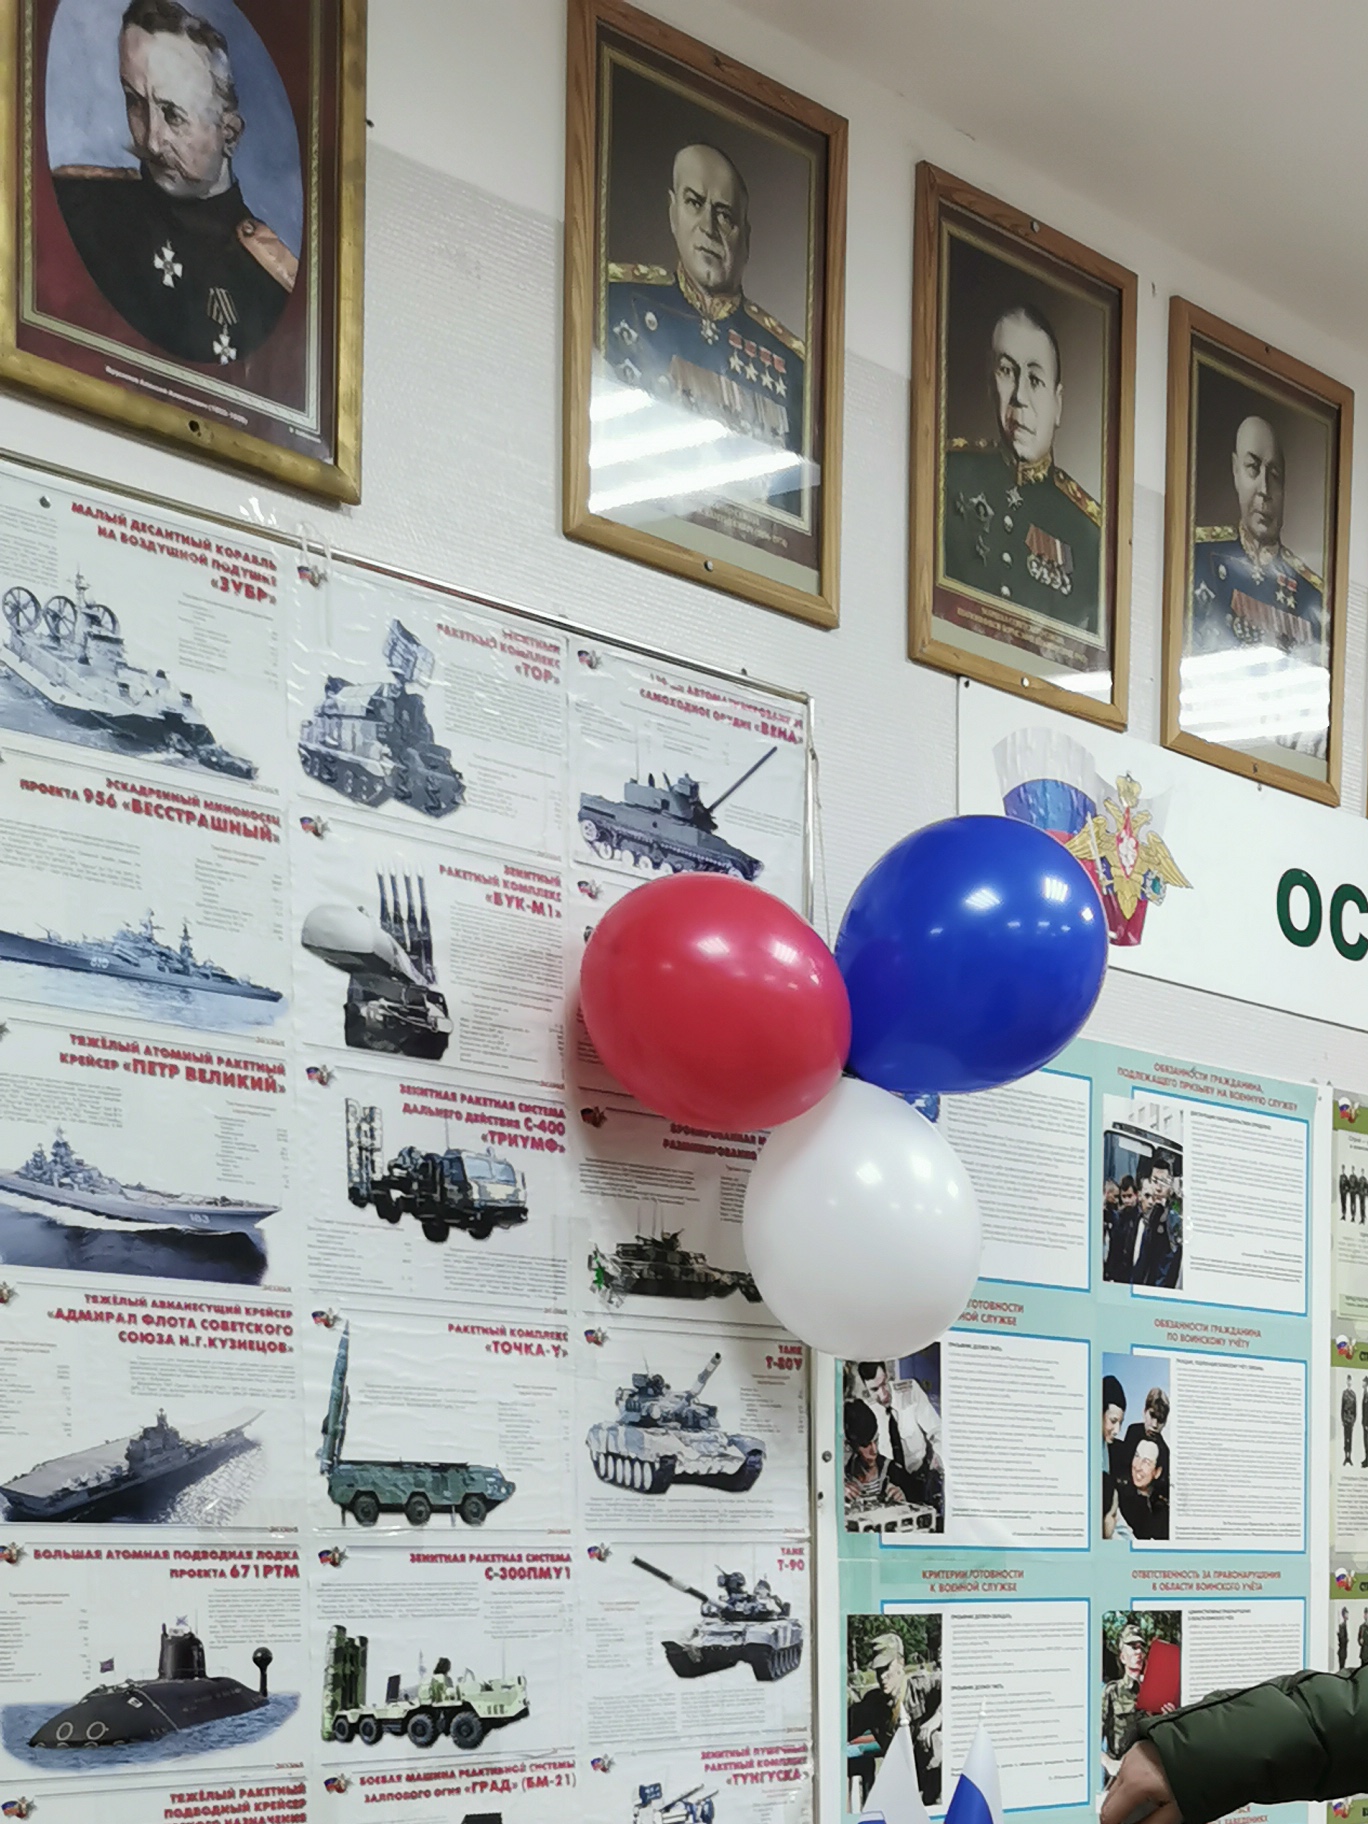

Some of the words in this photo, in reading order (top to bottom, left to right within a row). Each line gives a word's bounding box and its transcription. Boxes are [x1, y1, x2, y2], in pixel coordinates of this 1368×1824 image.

[71, 502, 127, 526] МАЛЫЙ
[130, 519, 212, 550] ДЕСАНТНЫЙ
[215, 543, 277, 571] КОРАБЛЬ
[98, 525, 117, 541] НА
[120, 532, 209, 565] ВОЗДУШНОЙ
[20, 779, 80, 801] ПРОЕКТА
[83, 788, 117, 809] 956
[106, 778, 200, 808] ЭСКАДРЕННЫЙ
[439, 864, 499, 888] РАКЕТНЫЙ
[59, 1052, 119, 1070] КРЕЙСЕР
[143, 1045, 213, 1065] АТОМНЫЙ
[216, 1056, 286, 1076] РАКЕТНЫЙ
[1154, 1062, 1208, 1081] ОБЯЗАННОСТИ
[400, 1083, 457, 1102] ЗЕНИТНАЯ
[460, 1093, 515, 1111] РАКЕТНАЯ
[518, 1102, 566, 1119] СИСТЕМА
[1217, 1089, 1227, 1098] НА
[1268, 1098, 1298, 1111] СЛУЖБУ
[402, 1103, 462, 1121] ДАЛЬНЕГО
[465, 1112, 520, 1130] ДЕЙСТВИЯ
[523, 1117, 566, 1135] С-400
[244, 1306, 293, 1319] КРЕЙСЕР
[981, 1313, 1017, 1326] СЛУЖБЕ
[142, 1314, 196, 1330] ФЛОТА
[200, 1319, 294, 1337] СОВЕТСКОГО
[448, 1323, 507, 1337] РАКЕТНЫЙ
[509, 1327, 568, 1342] КОМПЛЕКС
[1154, 1318, 1209, 1332] ОБЯЗАННОСТИ
[1211, 1325, 1261, 1338] ГРАЖДАНИНА
[118, 1331, 175, 1346] СОЮЗА
[1167, 1333, 1179, 1342] ПО
[1180, 1333, 1226, 1346] ВОИНСКОМУ
[33, 1549, 102, 1560] БОЛЬШАЯ
[106, 1549, 169, 1560] АТОМНАЯ
[173, 1549, 253, 1561] ПОДВОДНАЯ
[256, 1549, 299, 1561] ЛОДКА
[410, 1553, 466, 1564] ЗЕНИТНАЯ
[469, 1554, 523, 1564] РАКЕТНАЯ
[525, 1554, 572, 1563] СИСТЕМА
[170, 1568, 226, 1579] ПРОЕКТА
[777, 1558, 804, 1572] Т-90
[1131, 1570, 1199, 1579] ОТВЕТСТВЕННОСТЬ
[1202, 1570, 1211, 1579] ЗА
[1213, 1570, 1281, 1579] ПРАВОНАРУШЕНИЯ
[930, 1584, 936, 1593] К
[938, 1582, 980, 1593] ВОЕННОЙ
[982, 1582, 1017, 1592] СЛУЖБЕ
[1159, 1583, 1194, 1591] ОБЛАСТИ
[1196, 1583, 1241, 1591] ВОИНСКОГО
[359, 1774, 403, 1786] БОЕВАЯ
[405, 1770, 457, 1783] МАШИНА
[521, 1773, 577, 1792] (БМ-21)
[239, 1782, 306, 1799] РАКЕТНЫЙ
[164, 1803, 250, 1819] ПОДВОДНЫЙ
[254, 1798, 307, 1813] КРЕЙСЕР
